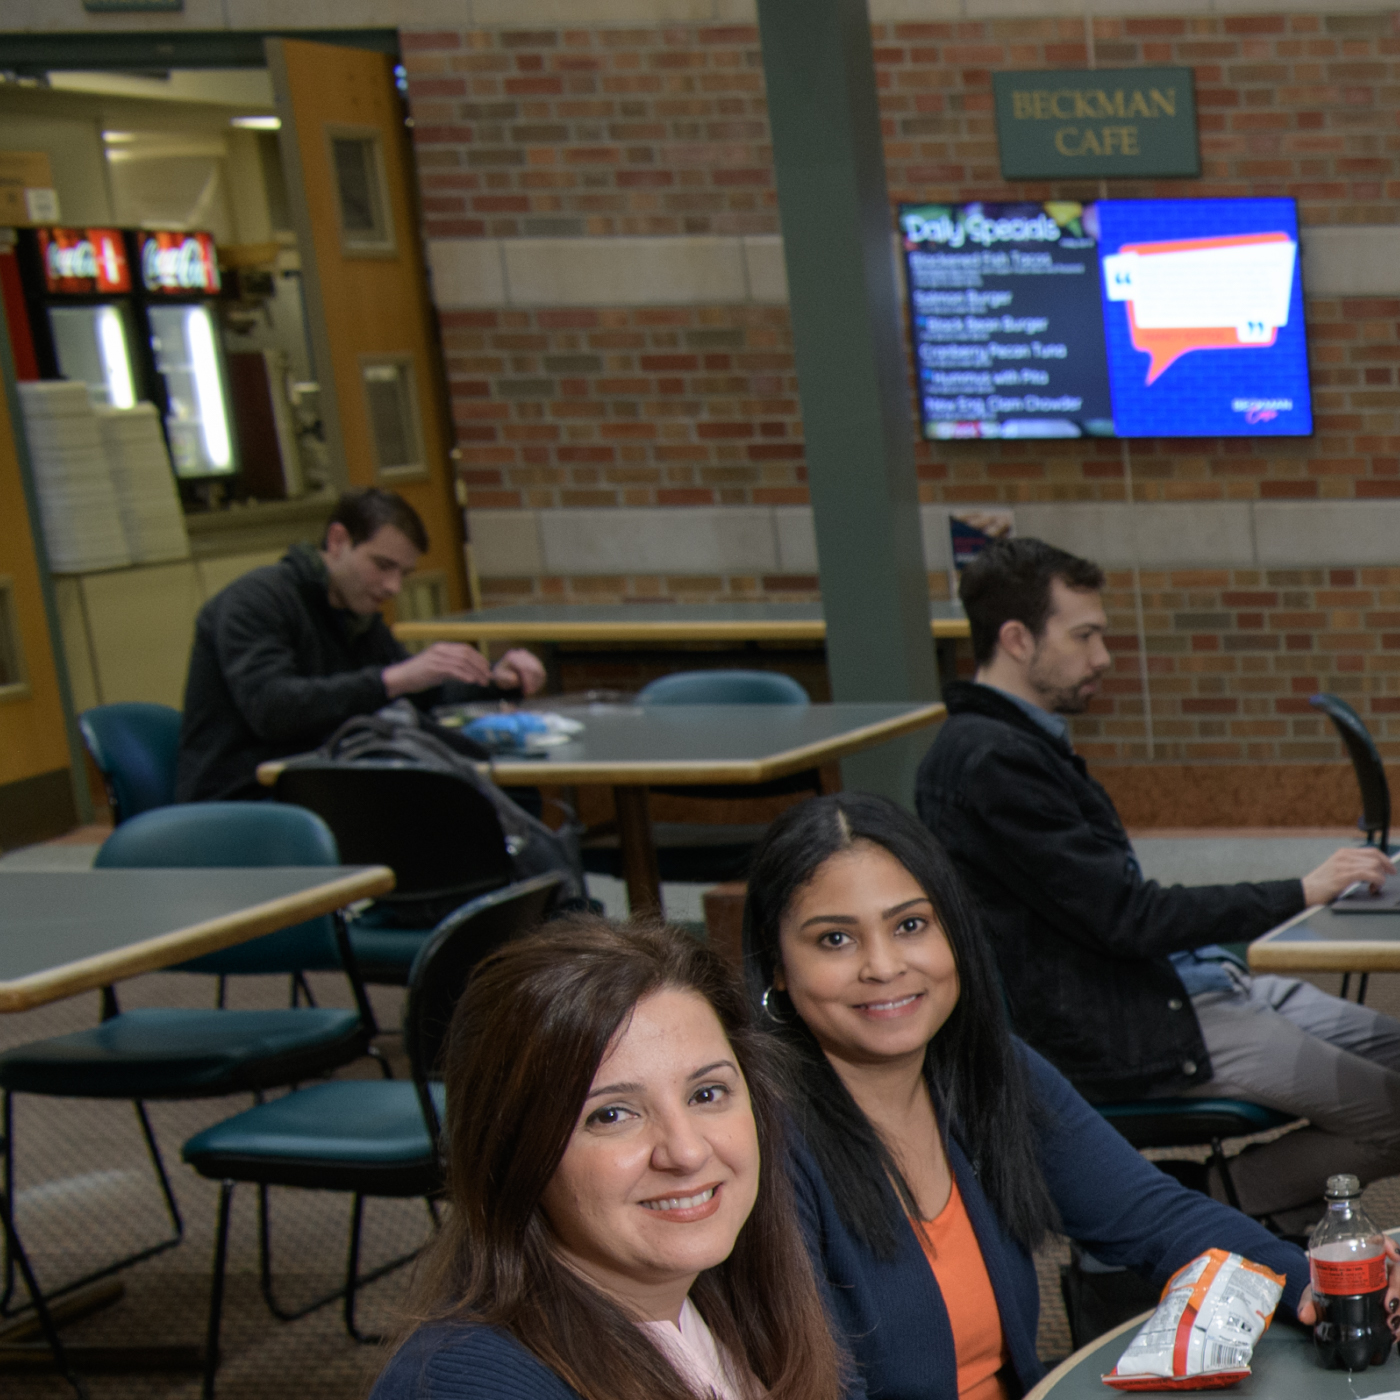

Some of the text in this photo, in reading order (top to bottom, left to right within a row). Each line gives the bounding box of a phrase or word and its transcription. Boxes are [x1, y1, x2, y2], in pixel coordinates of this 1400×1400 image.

[1013, 88, 1175, 119] BECKMAN
[1054, 125, 1140, 157] CAFE
[904, 213, 1061, 248] Daily Specials
[965, 288, 1013, 308] Burger
[927, 314, 1049, 335] Black Bean Burger
[1031, 340, 1067, 359] Tuna
[924, 396, 956, 413] New
[986, 394, 1023, 413] Clam
[1024, 393, 1083, 413] Chowder
[1232, 398, 1294, 413] BECKMAN
